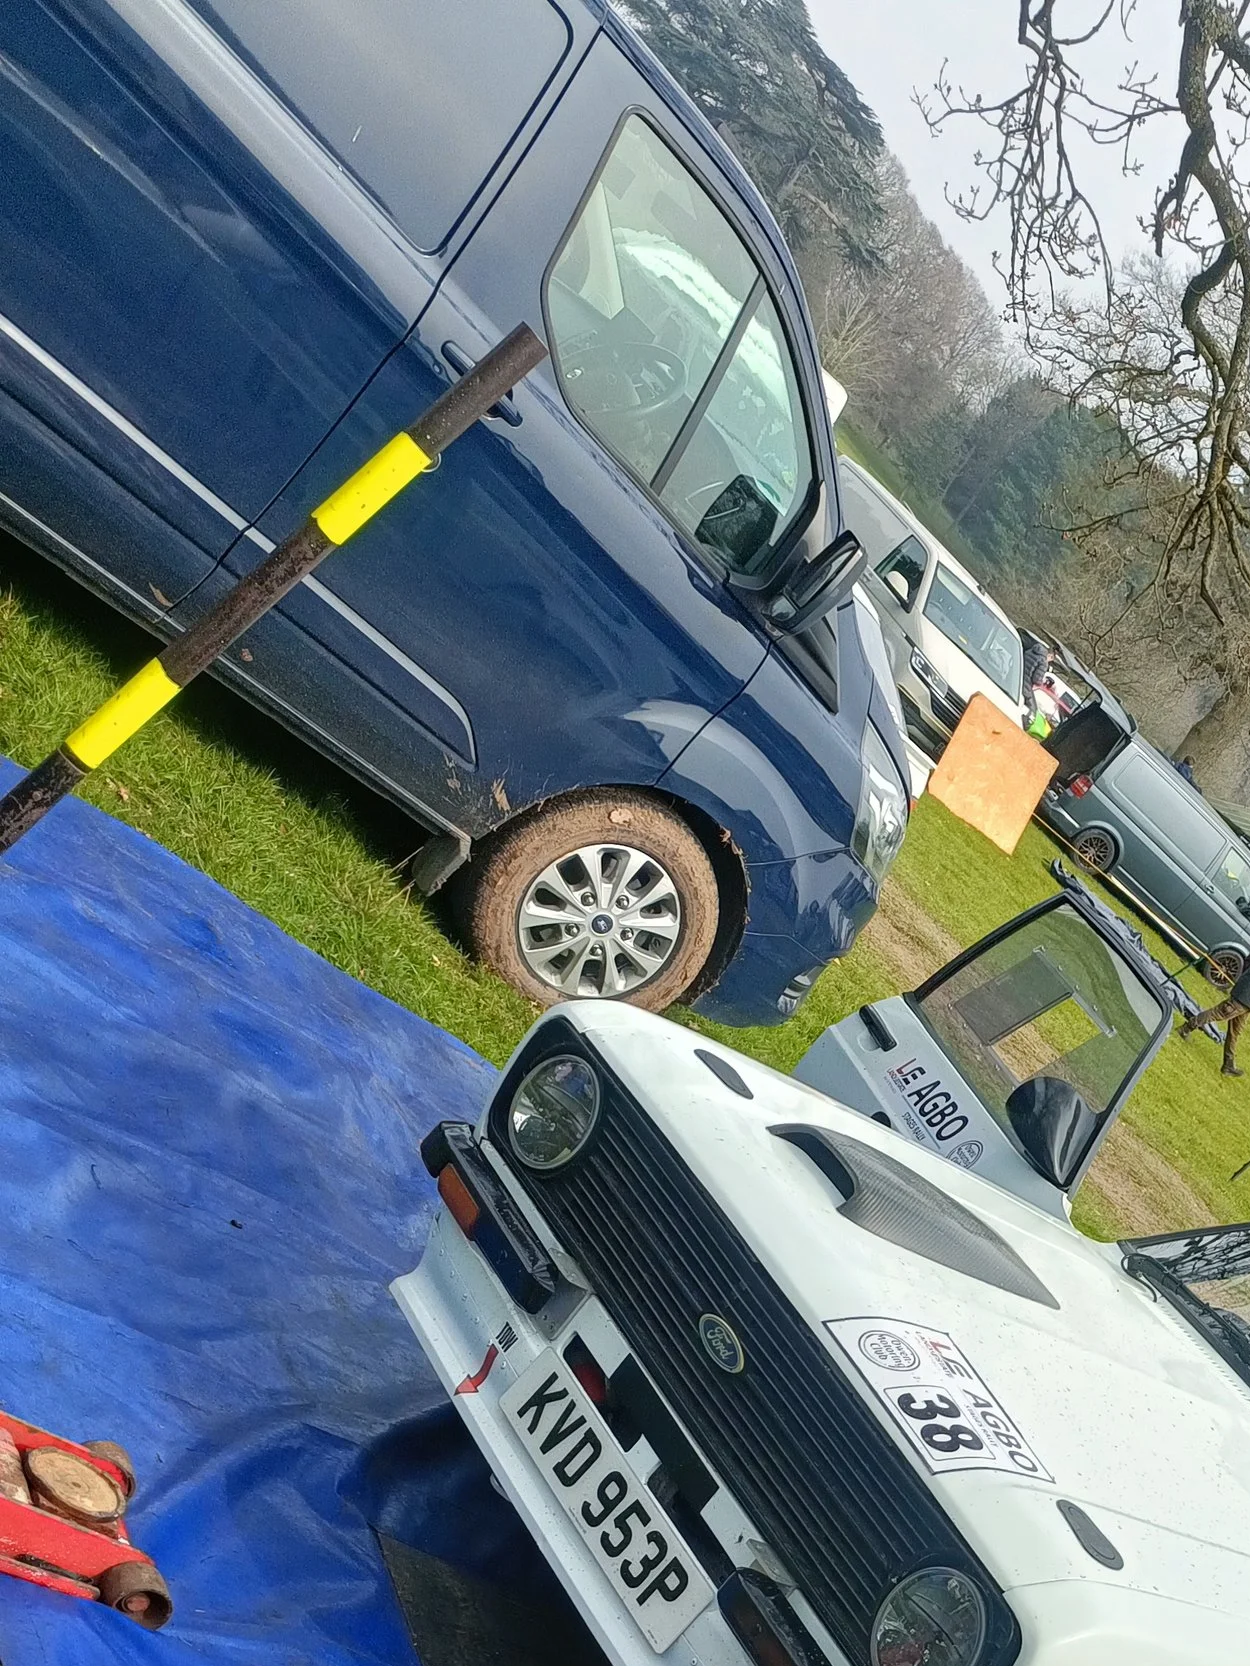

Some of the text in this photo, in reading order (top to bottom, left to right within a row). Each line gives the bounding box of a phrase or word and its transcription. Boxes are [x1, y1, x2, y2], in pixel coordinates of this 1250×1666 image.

[902, 1112, 926, 1141] STAGES RALLY
[907, 1080, 969, 1141] AGBO
[495, 1322, 519, 1353] TOW
[897, 1392, 984, 1453] 38
[962, 1389, 1039, 1472] AGBO
[516, 1371, 690, 1607] KVD 953P
